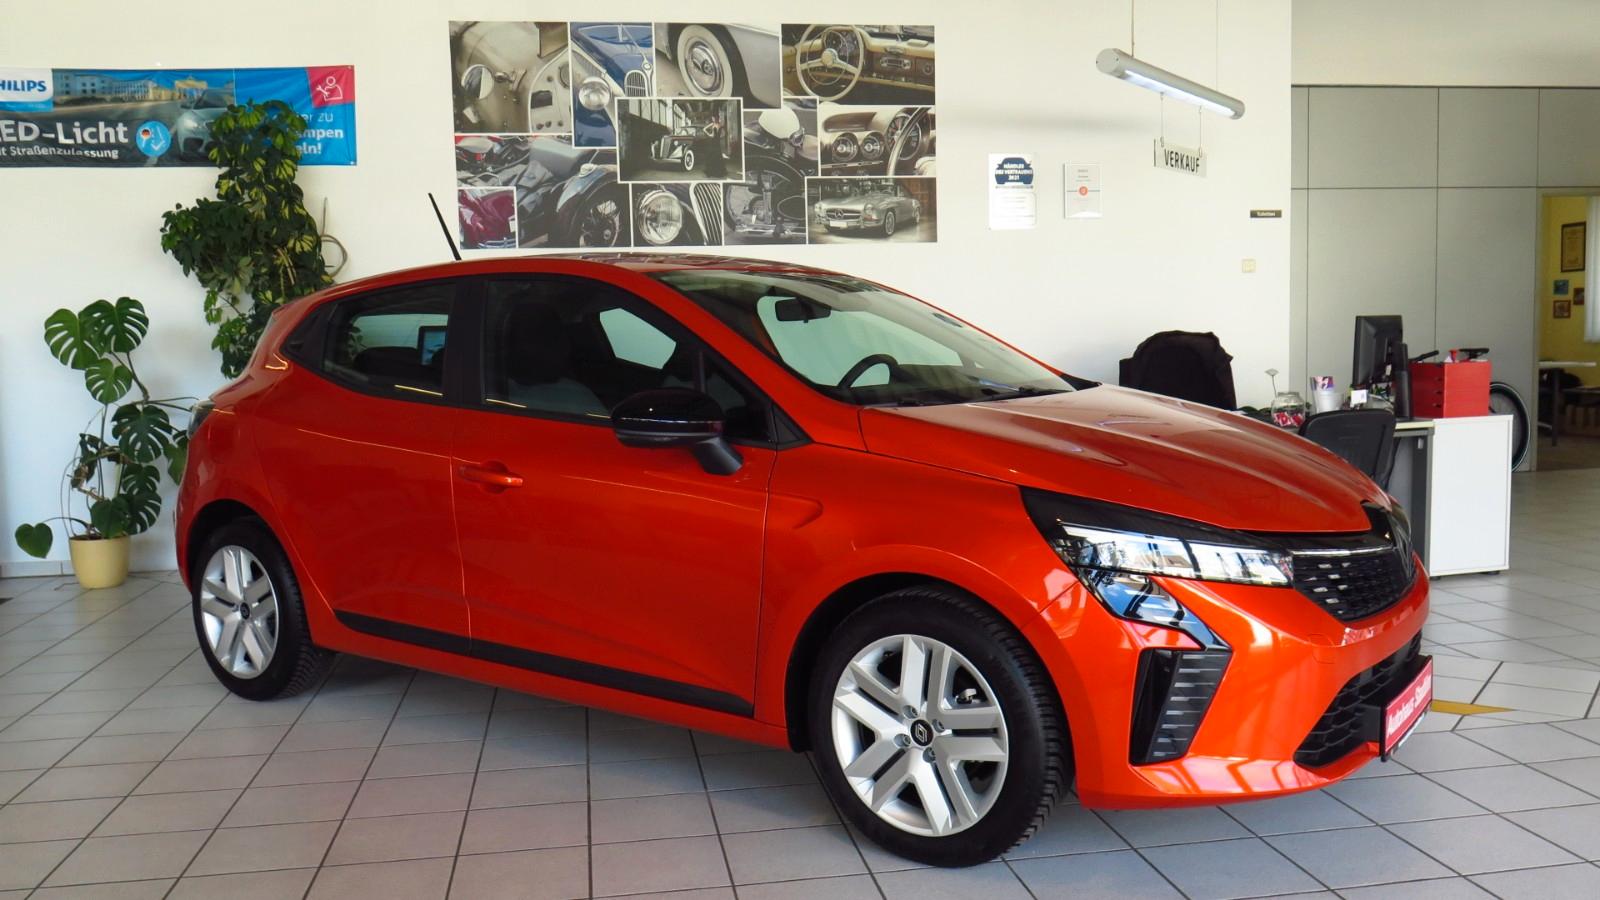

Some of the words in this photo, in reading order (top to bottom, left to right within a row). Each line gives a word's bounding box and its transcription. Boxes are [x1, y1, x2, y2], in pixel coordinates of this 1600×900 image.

[0, 79, 47, 92] HILIPS
[0, 119, 129, 144] ED-Licht
[10, 145, 119, 159] Straßenzulassung
[1164, 148, 1200, 173] VERKAUF
